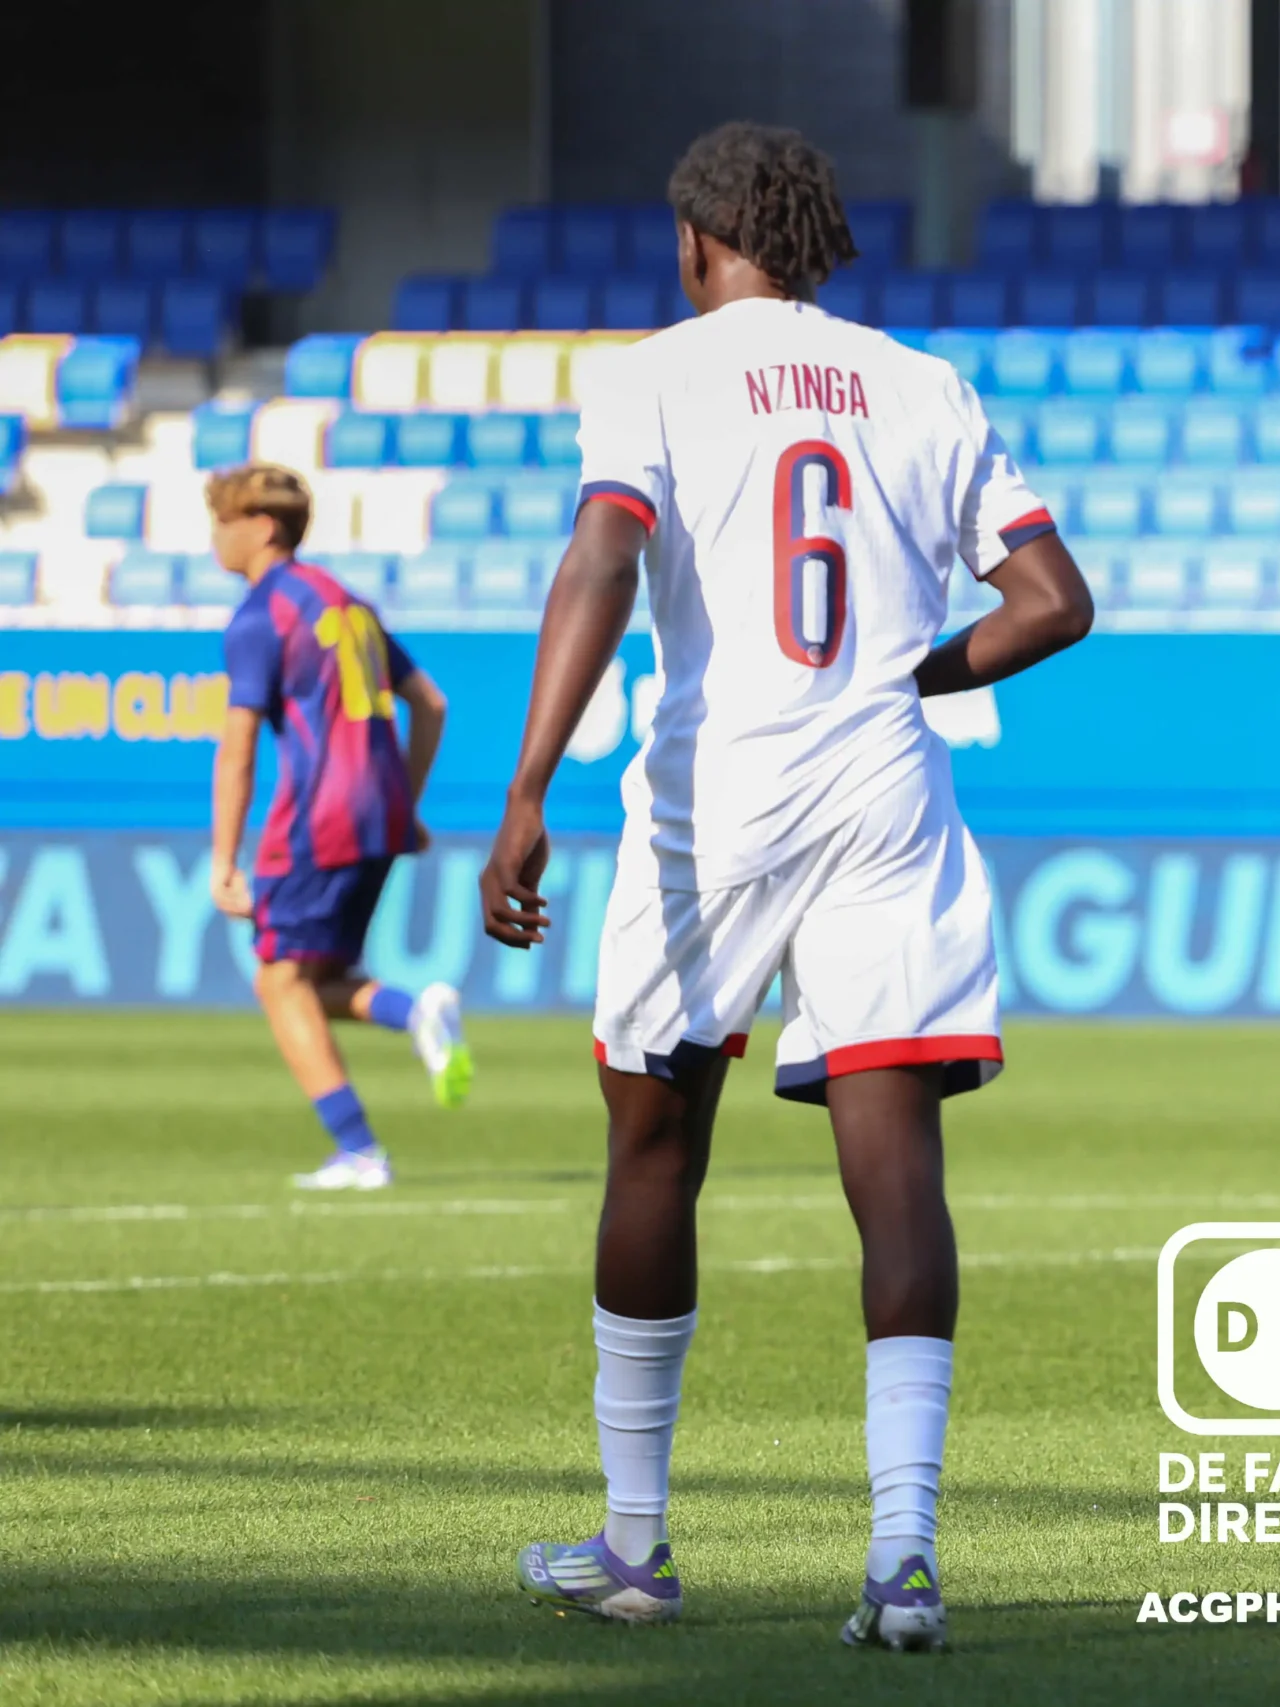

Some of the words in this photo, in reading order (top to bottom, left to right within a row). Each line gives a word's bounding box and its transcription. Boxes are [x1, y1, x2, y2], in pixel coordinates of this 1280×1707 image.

[745, 363, 870, 418] NZINGA
[772, 438, 853, 669] 6
[34, 671, 110, 739] UN
